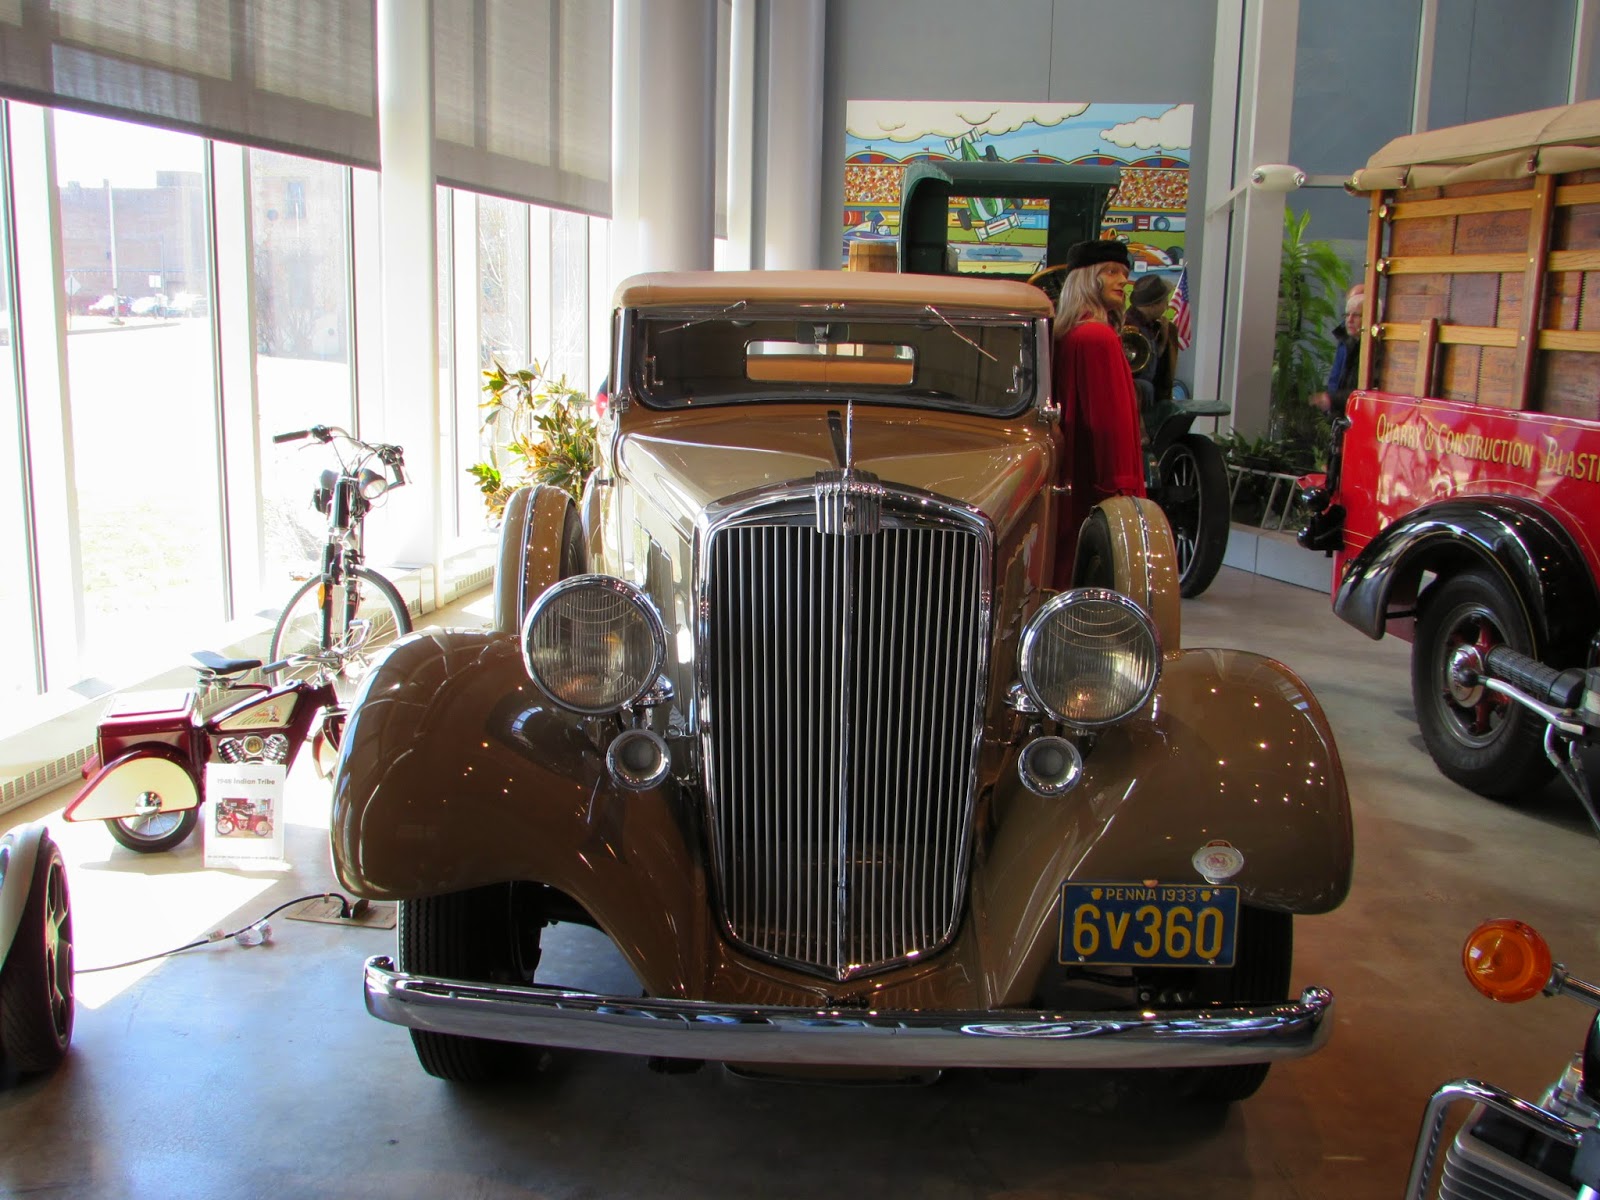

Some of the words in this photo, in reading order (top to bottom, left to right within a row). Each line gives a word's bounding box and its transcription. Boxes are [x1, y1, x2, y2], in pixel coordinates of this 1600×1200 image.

[1424, 421, 1435, 451] &
[1437, 423, 1534, 469] CONSTRUCTION
[233, 777, 256, 785] Indian
[1106, 888, 1157, 901] PENNA
[1162, 888, 1197, 902] 1933
[1073, 903, 1224, 959] 6V360
